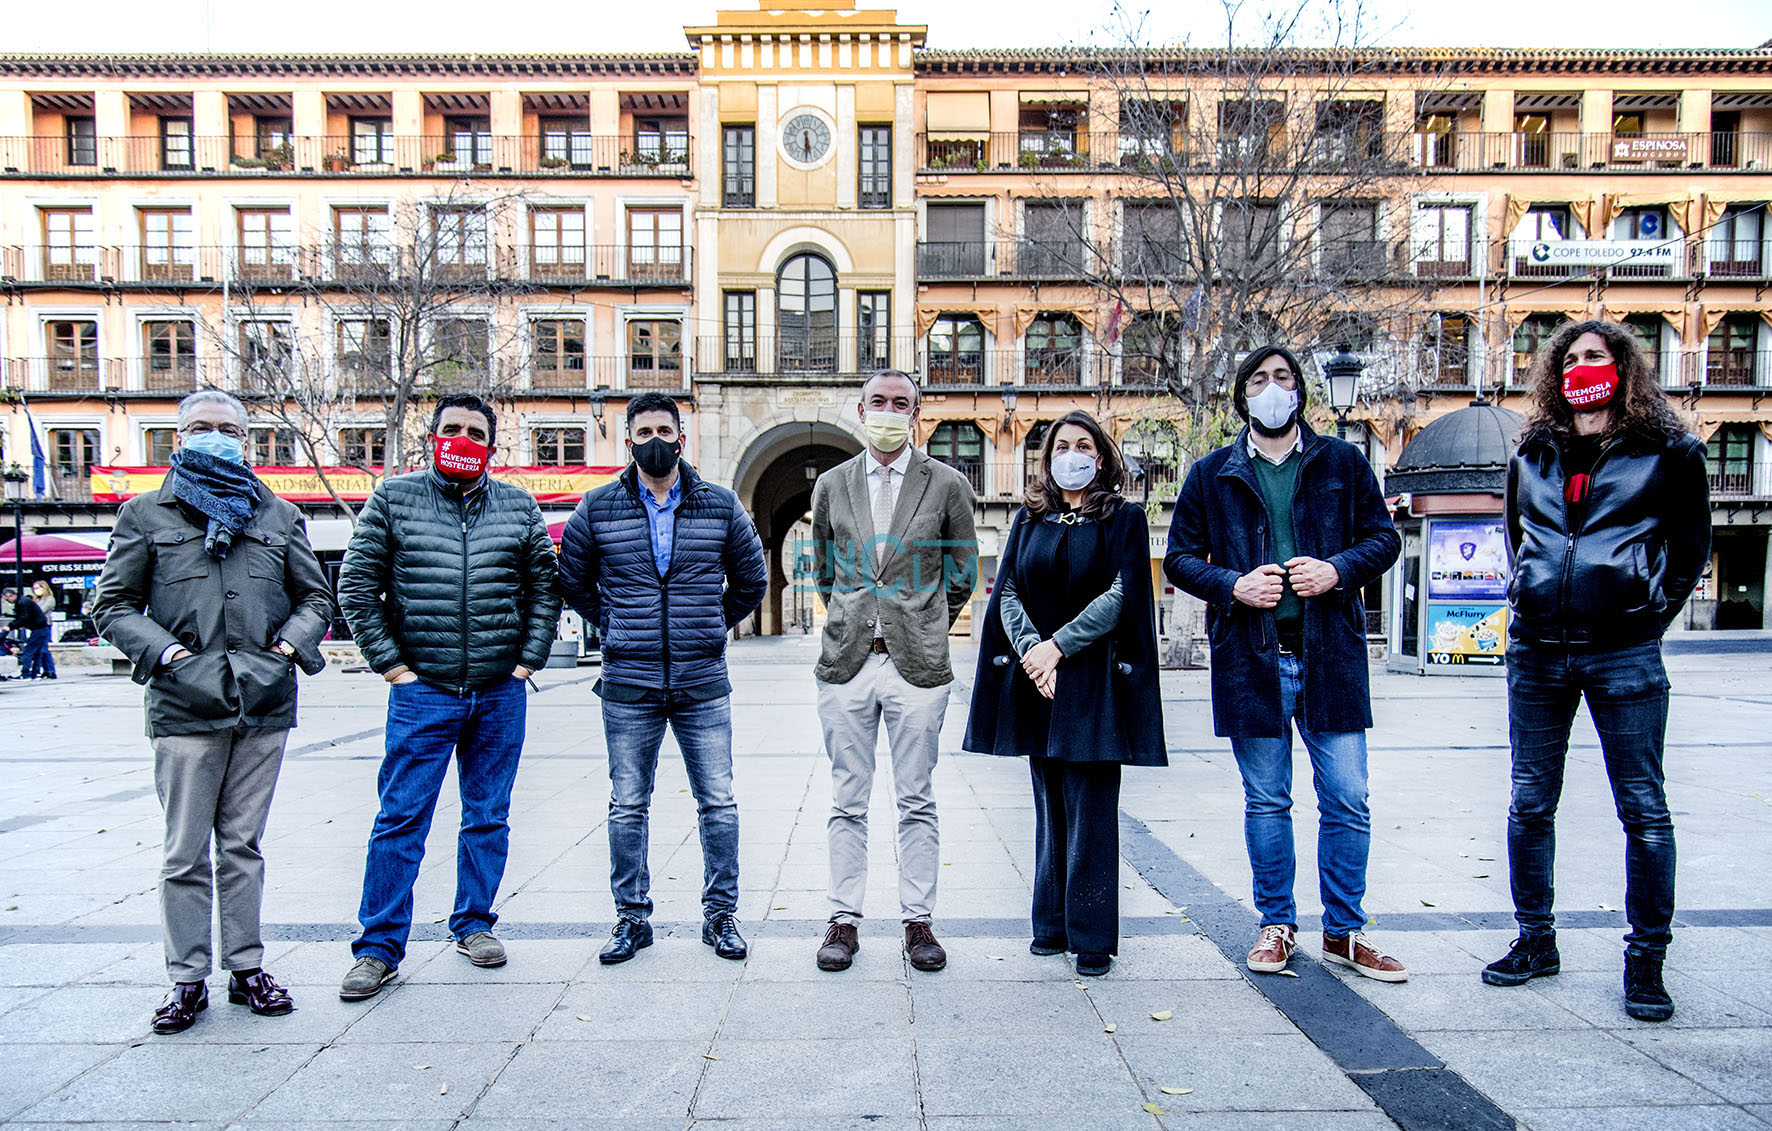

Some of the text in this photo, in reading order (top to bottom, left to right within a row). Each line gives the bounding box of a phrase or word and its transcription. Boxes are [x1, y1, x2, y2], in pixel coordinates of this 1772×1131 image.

[1632, 141, 1687, 151] ESPINOSA
[1553, 247, 1672, 257] COPE TOLEDO 97.4 FM
[441, 440, 451, 452] #
[440, 451, 481, 465] SALVEMOSLA
[1446, 610, 1486, 620] McFlurry
[1432, 653, 1451, 664] YO
